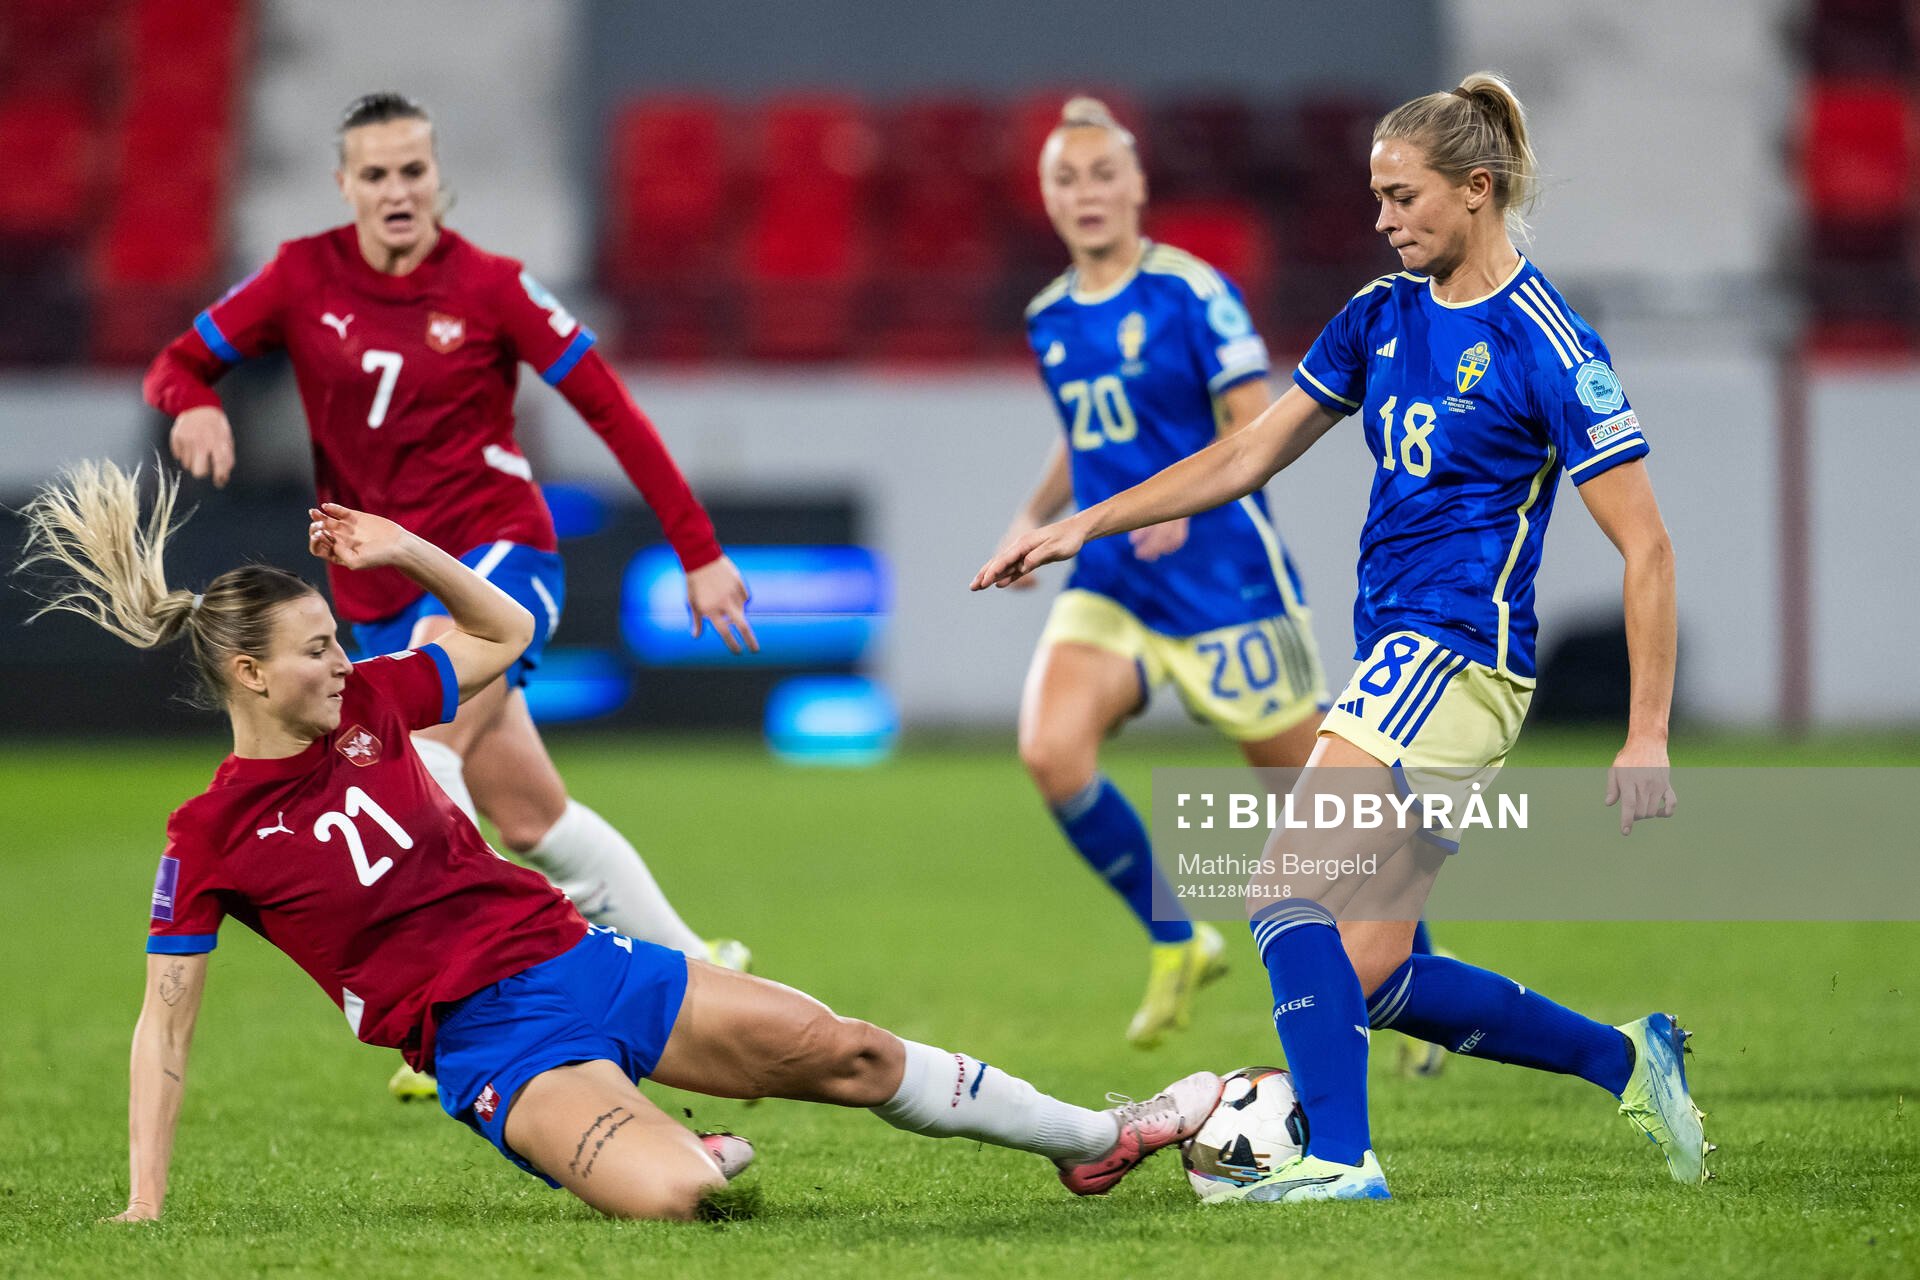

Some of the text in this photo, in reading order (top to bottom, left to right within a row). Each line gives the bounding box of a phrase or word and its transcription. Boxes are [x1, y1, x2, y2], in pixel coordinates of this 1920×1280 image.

[361, 349, 403, 429] 7
[1059, 375, 1138, 451] 20
[1379, 395, 1437, 478] 18
[1591, 417, 1637, 442] FOUNDATIO
[1197, 630, 1279, 699] 20
[313, 786, 413, 887] 21
[1273, 994, 1316, 1021] RIGE
[1457, 1029, 1486, 1052] IGE
